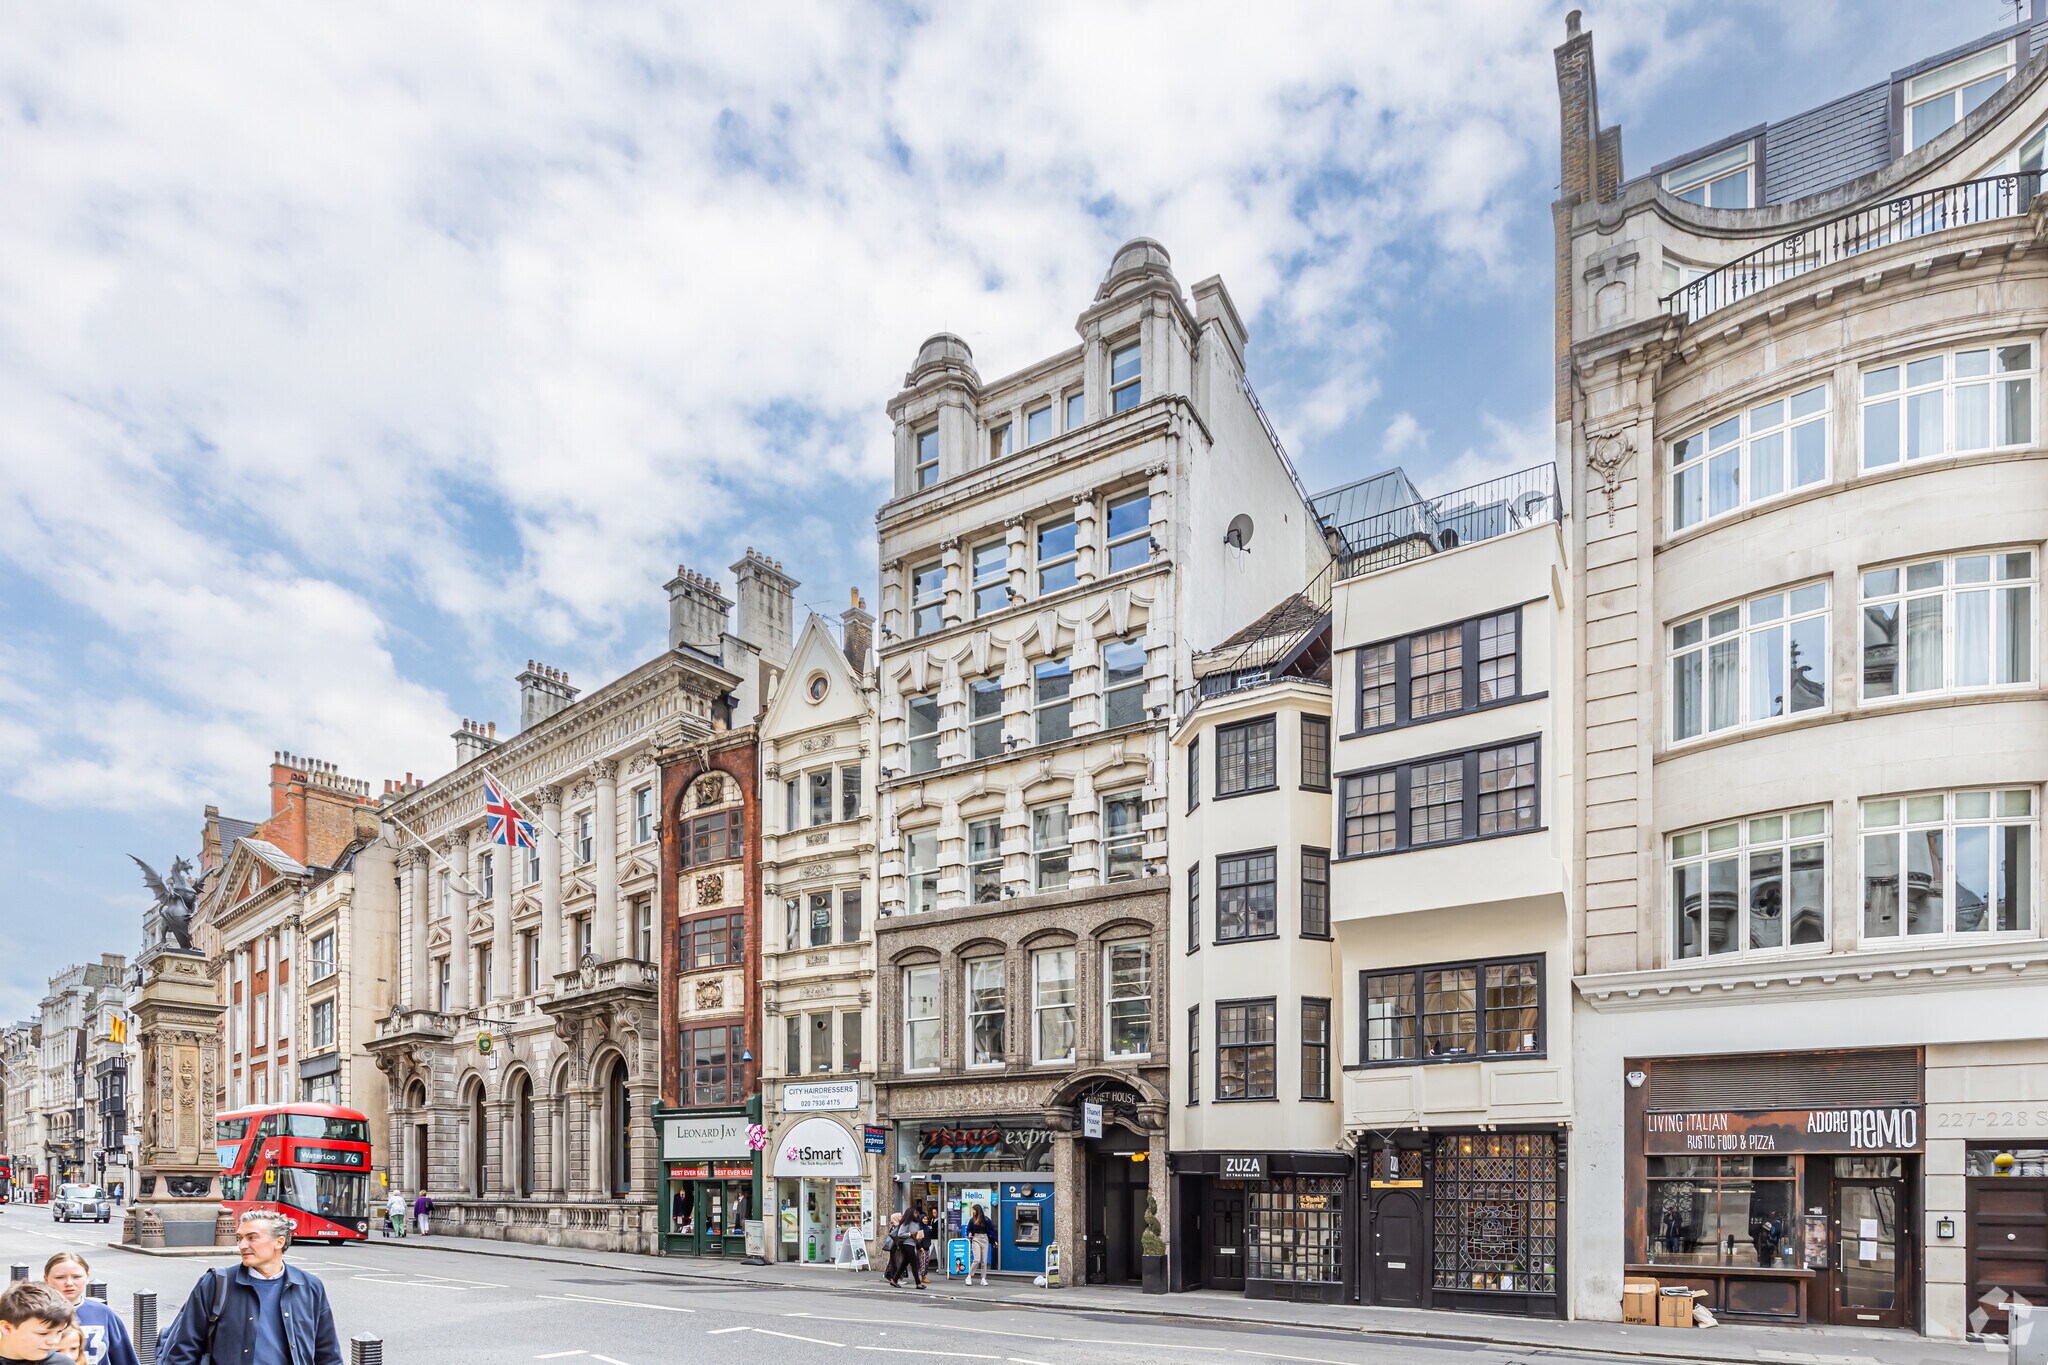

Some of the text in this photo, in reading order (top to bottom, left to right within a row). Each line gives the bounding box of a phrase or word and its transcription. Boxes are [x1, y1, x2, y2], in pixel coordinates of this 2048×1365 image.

[804, 1086, 853, 1094] HAIRDRESSERS
[1112, 1092, 1135, 1105] HOUSE
[1086, 1107, 1100, 1116] Thanet
[1648, 1114, 1728, 1132] LIVING ITALIAN
[1938, 1112, 2028, 1128] 227-228
[677, 1125, 738, 1139] LEONARD JAY
[929, 1128, 999, 1145] TESCO
[1688, 1135, 1775, 1150] RUSTIC FOOD & PIZZA
[301, 1152, 358, 1163] Waterloo 76
[1226, 1158, 1260, 1172] ZUZA
[1626, 1316, 1646, 1324] large
